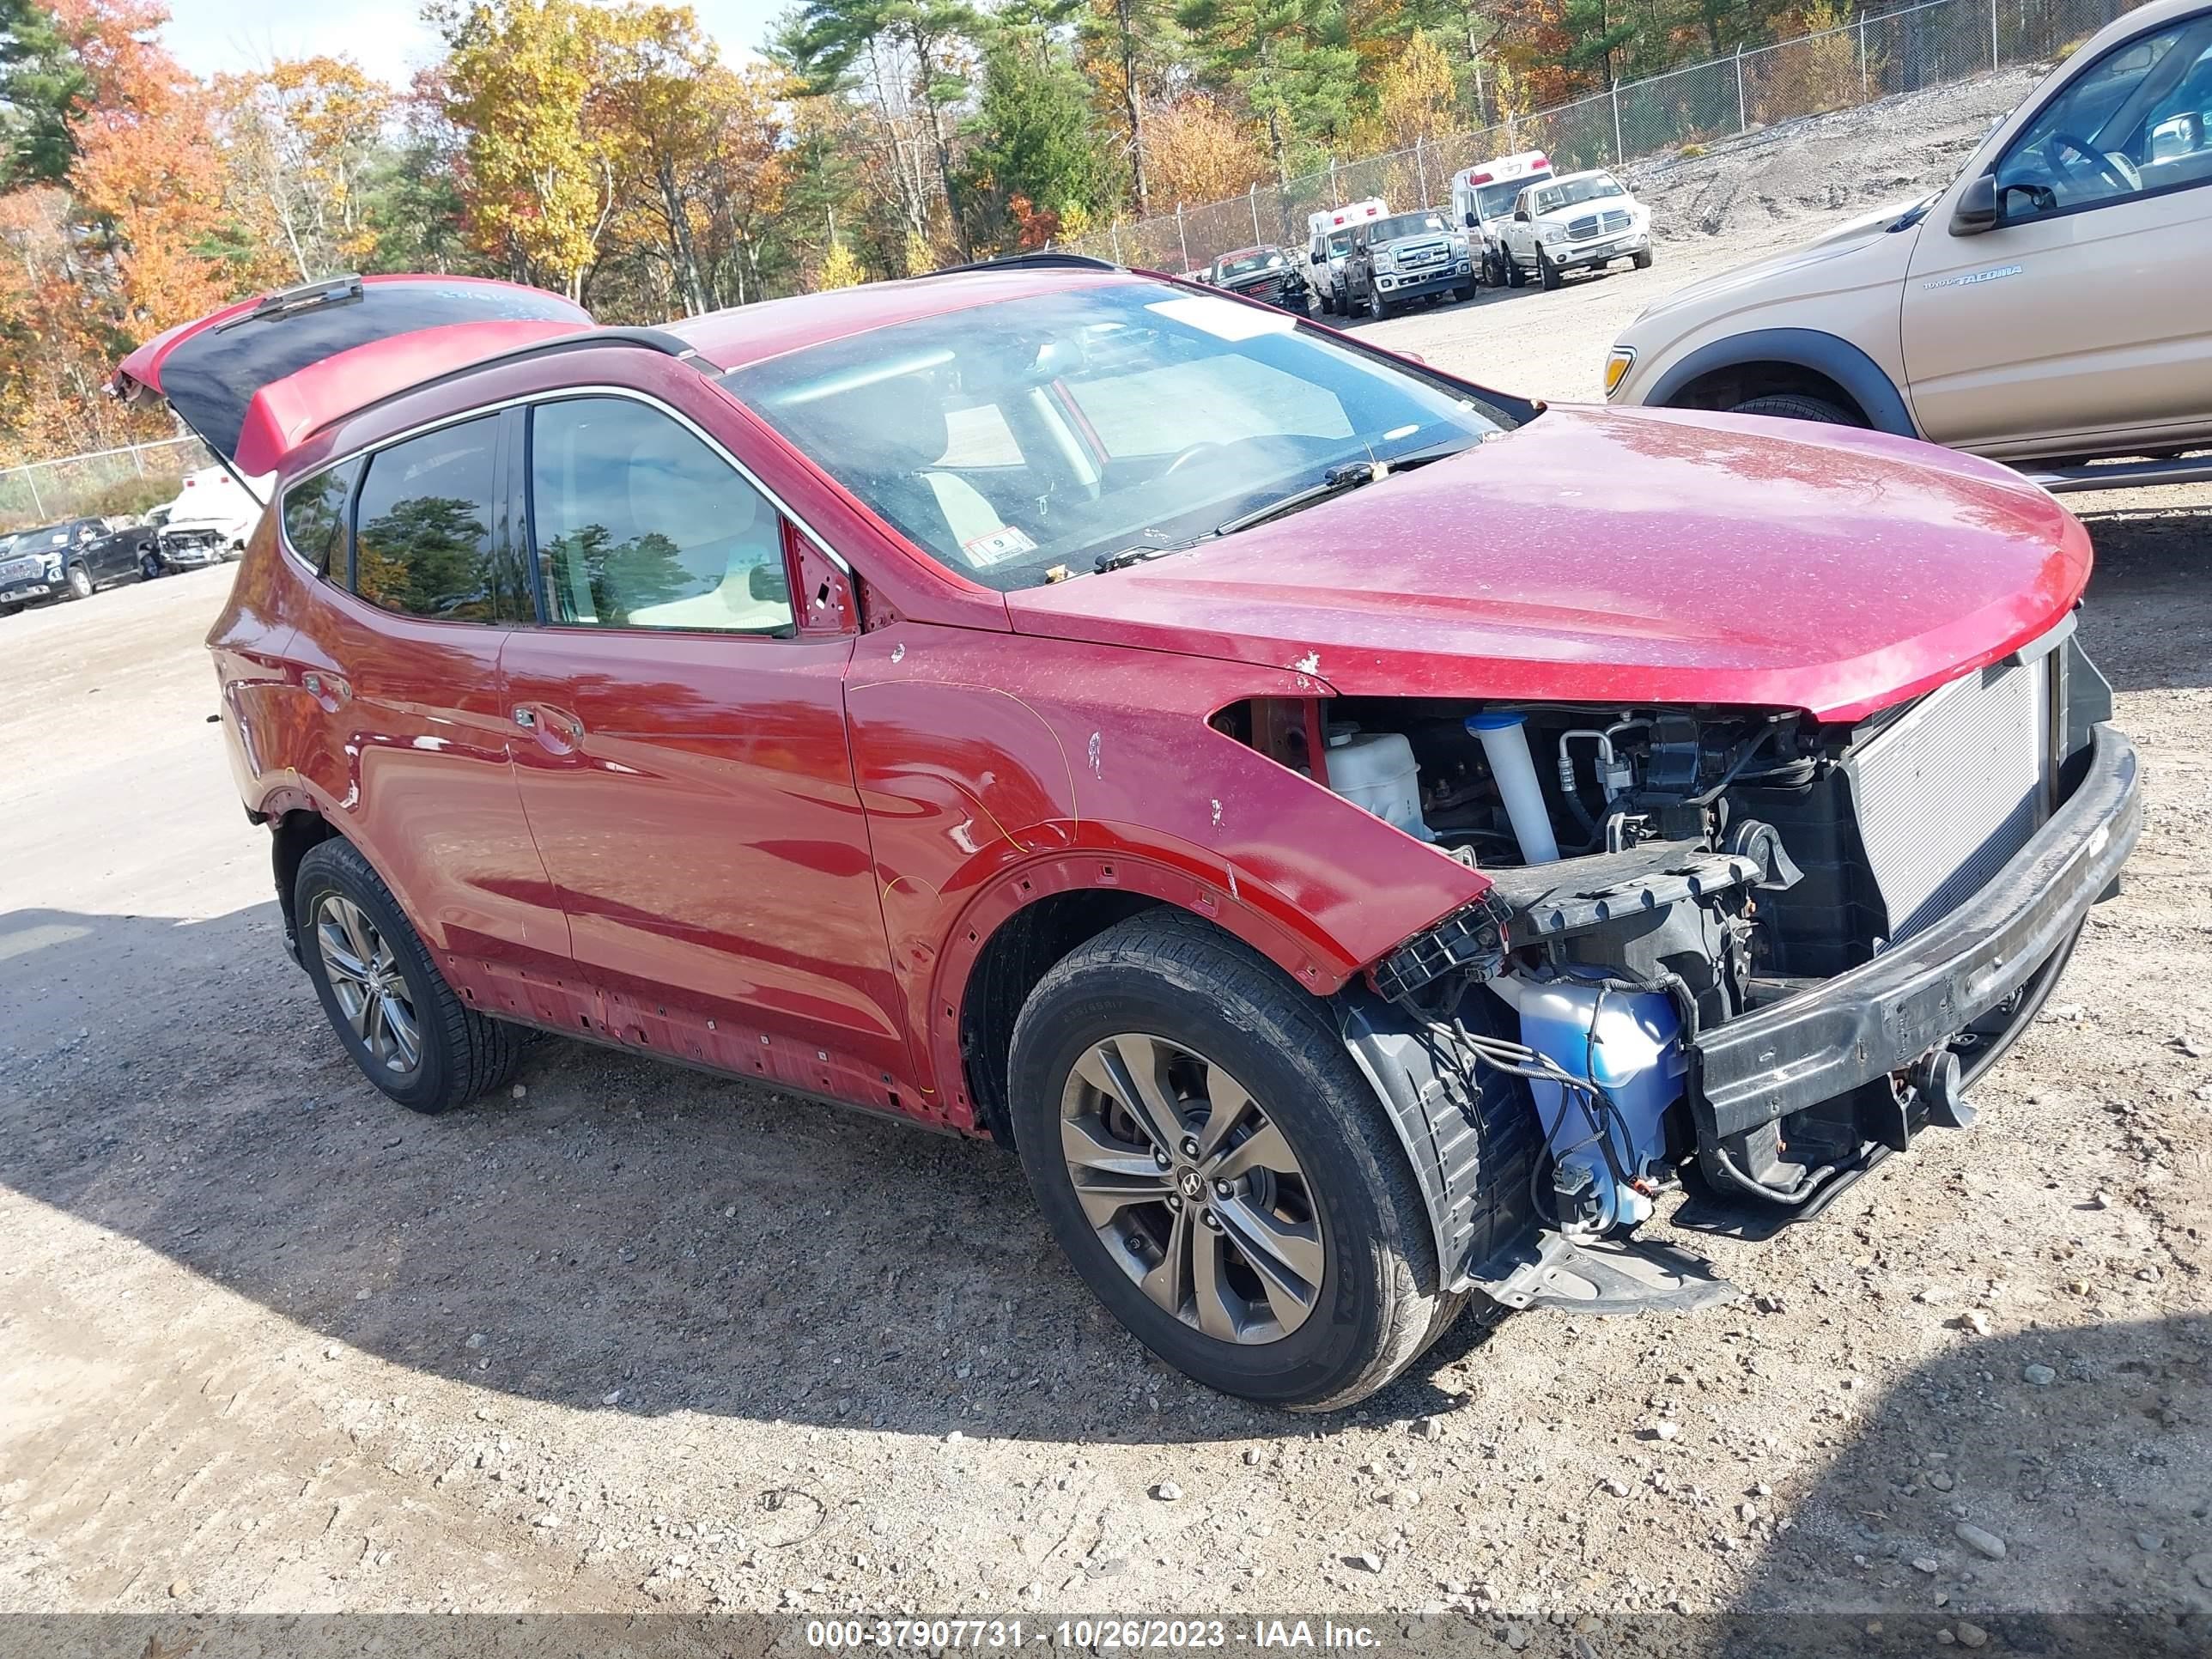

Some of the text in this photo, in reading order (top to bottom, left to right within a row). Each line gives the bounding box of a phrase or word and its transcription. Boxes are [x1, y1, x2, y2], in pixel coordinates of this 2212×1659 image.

[1923, 265, 2022, 289] TOYOTA TACOMA
[994, 539, 1004, 548] 9
